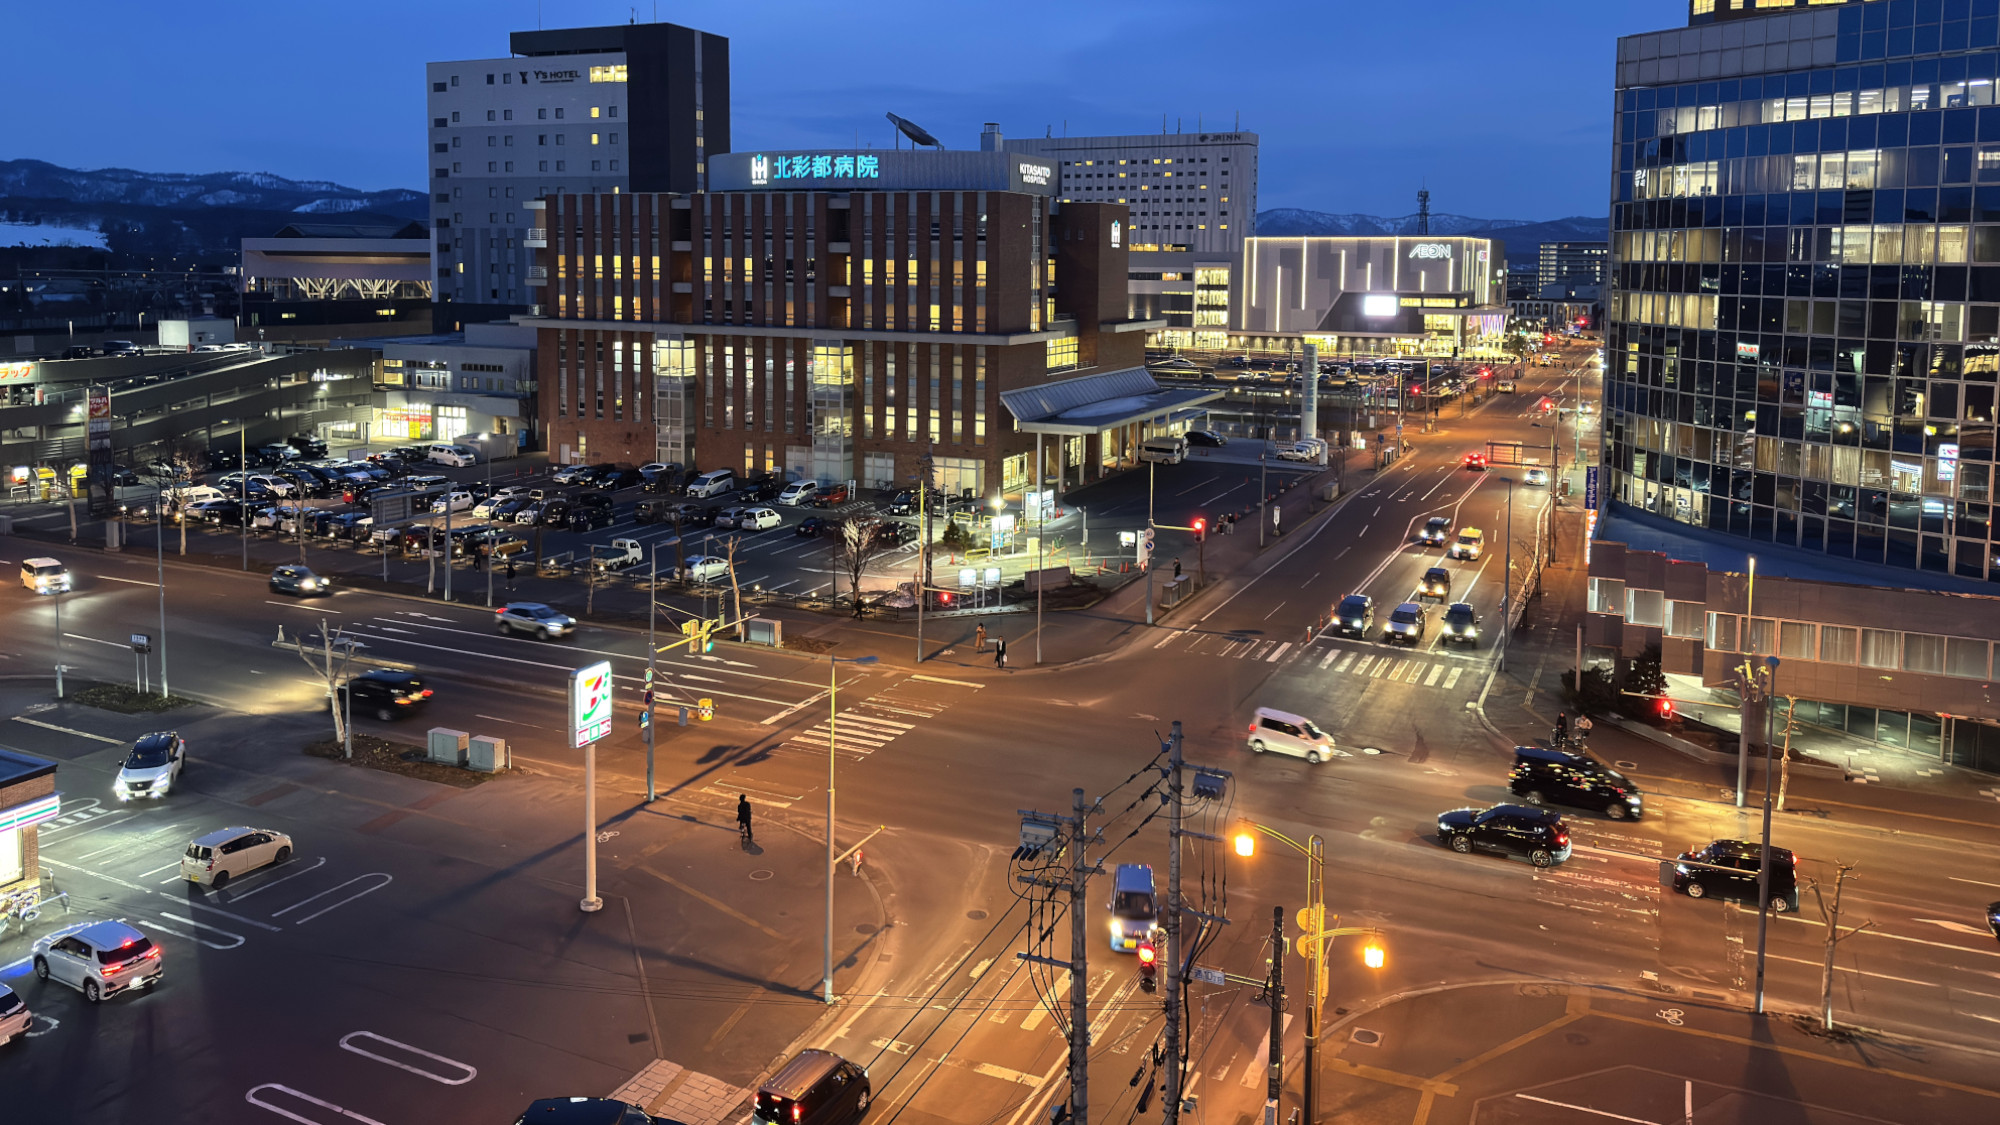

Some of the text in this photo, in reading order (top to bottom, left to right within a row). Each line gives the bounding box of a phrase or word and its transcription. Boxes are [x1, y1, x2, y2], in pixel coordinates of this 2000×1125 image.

[549, 70, 581, 79] HOTEL
[773, 155, 879, 179] 北彩都病院
[1019, 163, 1051, 178] KITASAITO
[1022, 174, 1047, 186] HOSPITAL
